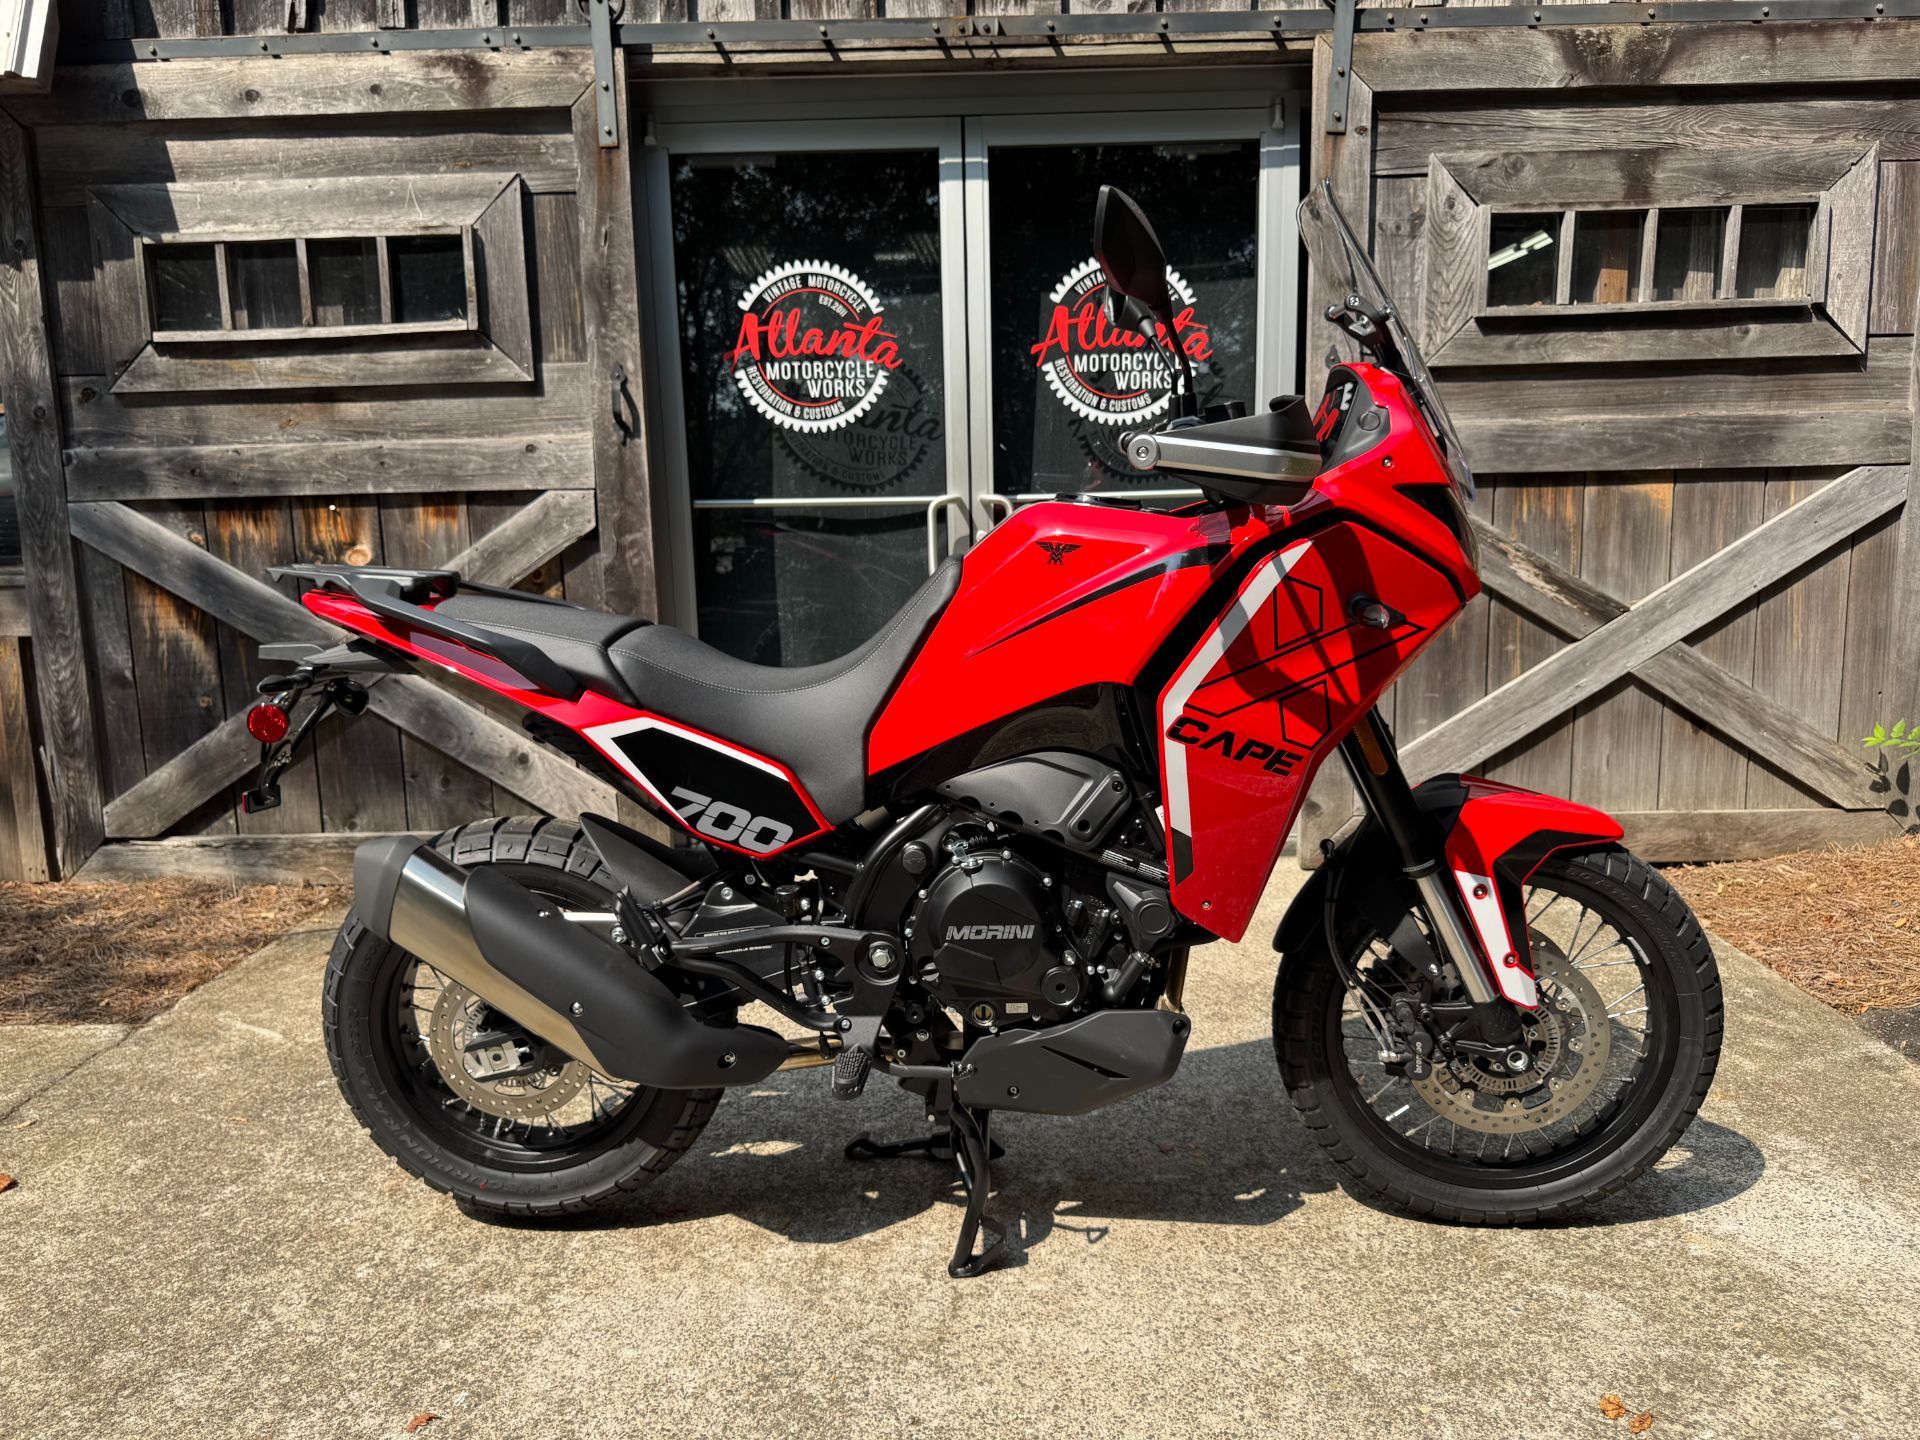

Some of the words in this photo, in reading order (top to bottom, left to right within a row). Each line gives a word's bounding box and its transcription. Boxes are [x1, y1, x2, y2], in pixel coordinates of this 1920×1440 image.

[762, 275, 802, 303] VINTAGE
[807, 275, 867, 313] MOTORCYCLE
[1074, 271, 1107, 295] VINTA
[723, 308, 903, 373] Atlanta
[766, 360, 875, 380] MOTORCYCLE
[807, 379, 866, 398] WORKS
[1054, 356, 1098, 408] RESTORATION
[1099, 399, 1107, 411] &
[1109, 393, 1151, 412] CUSTOMS
[1114, 371, 1172, 391] WORKS
[747, 365, 796, 417] RESTORATION
[793, 406, 801, 418] &
[803, 401, 845, 420] CUSTOMS
[1166, 716, 1304, 776] CAPE
[671, 786, 793, 854] 700
[946, 924, 1035, 941] MORINI
